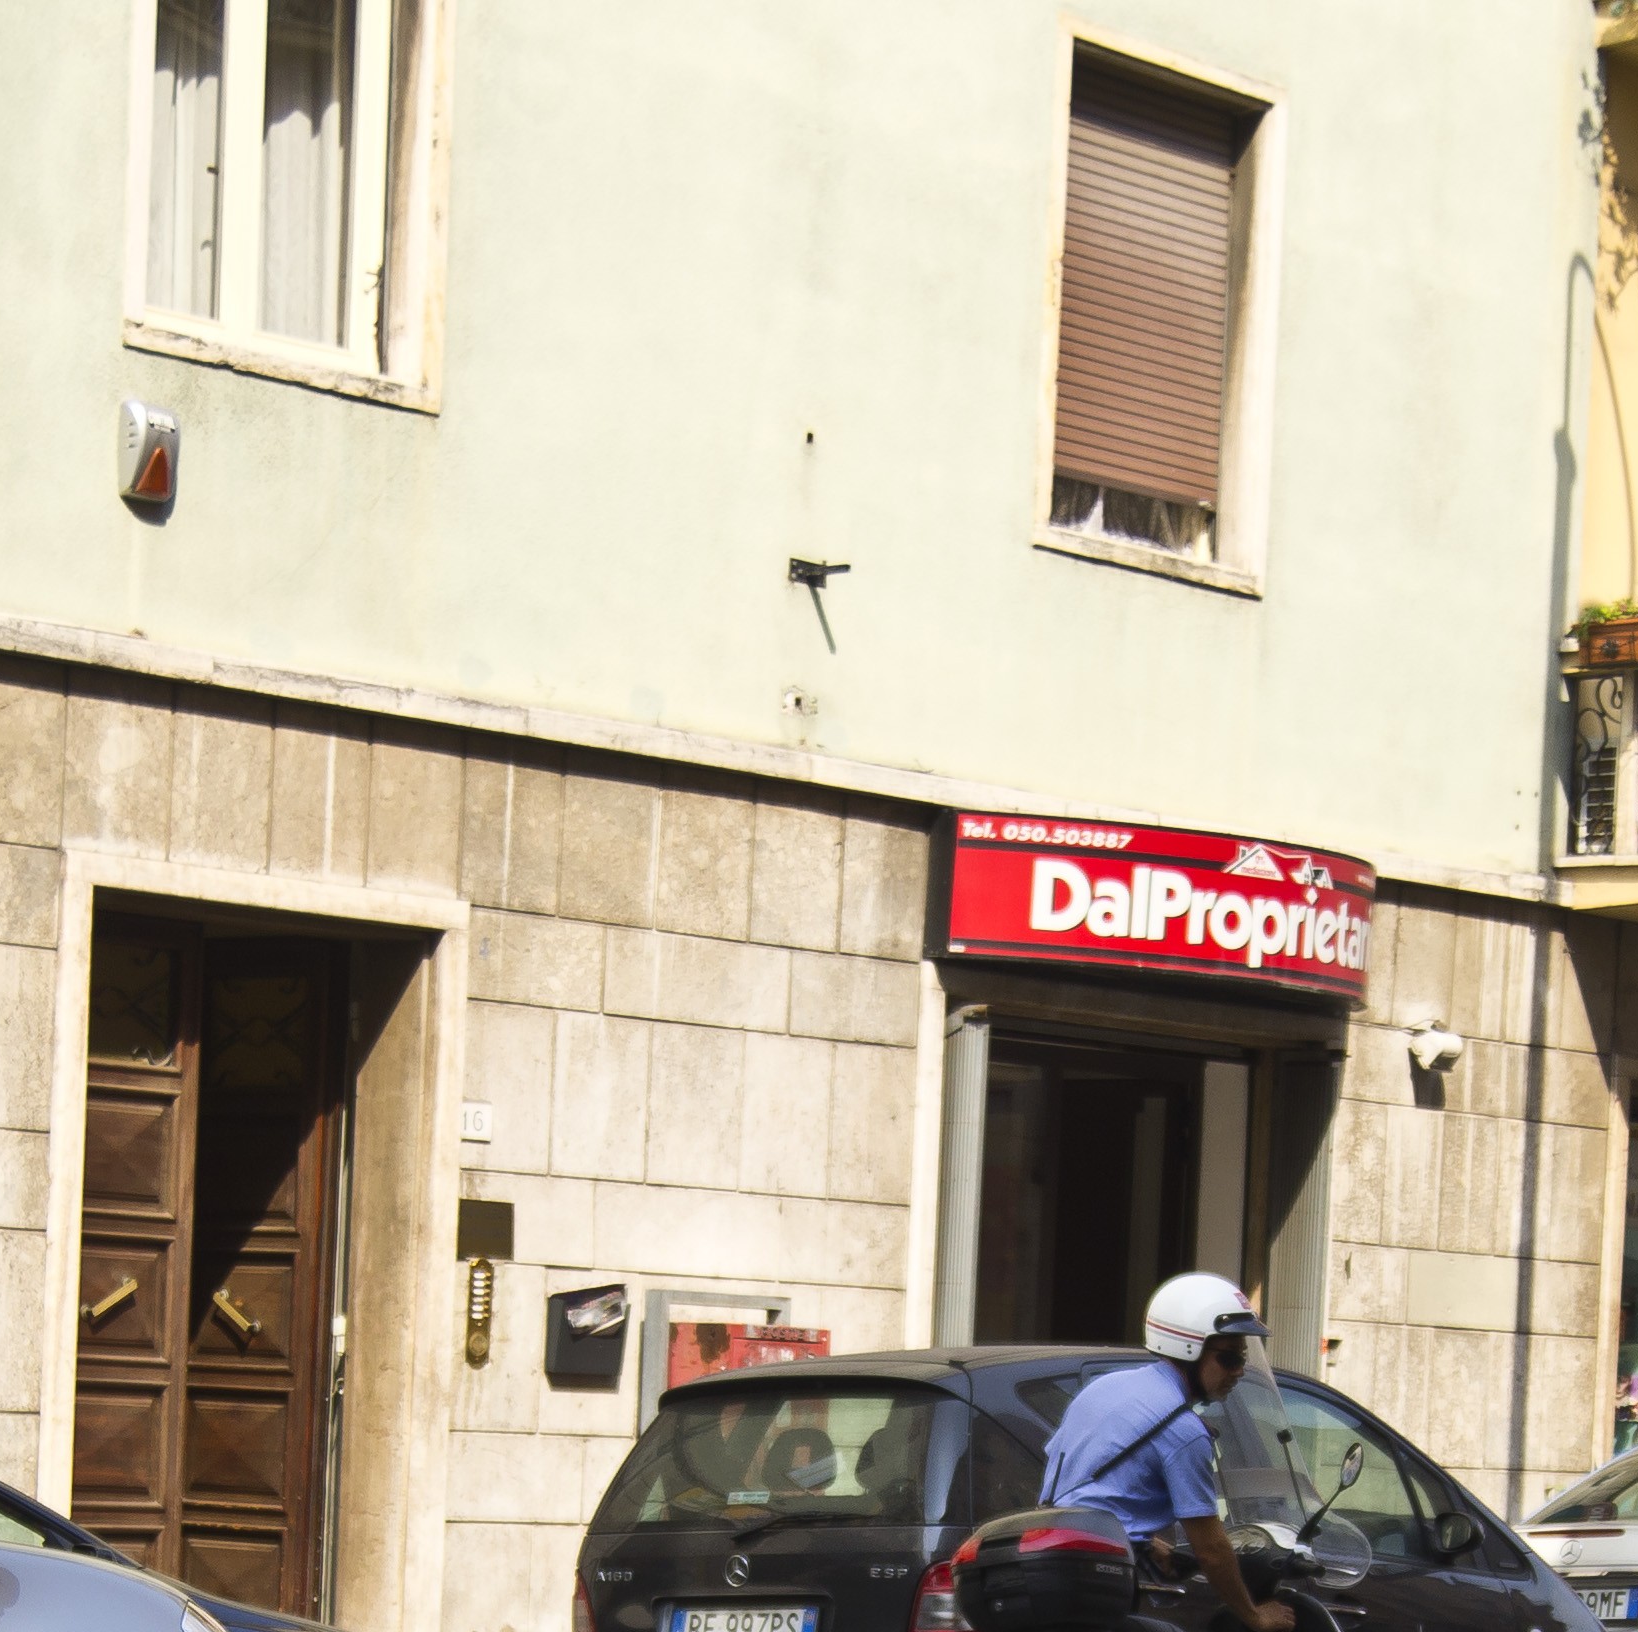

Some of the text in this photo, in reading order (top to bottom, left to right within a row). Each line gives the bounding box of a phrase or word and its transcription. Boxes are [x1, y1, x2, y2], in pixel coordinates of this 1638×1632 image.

[962, 822, 1134, 849] Tel. 050.503887
[462, 1110, 484, 1132] 16
[870, 1566, 909, 1579] ESP
